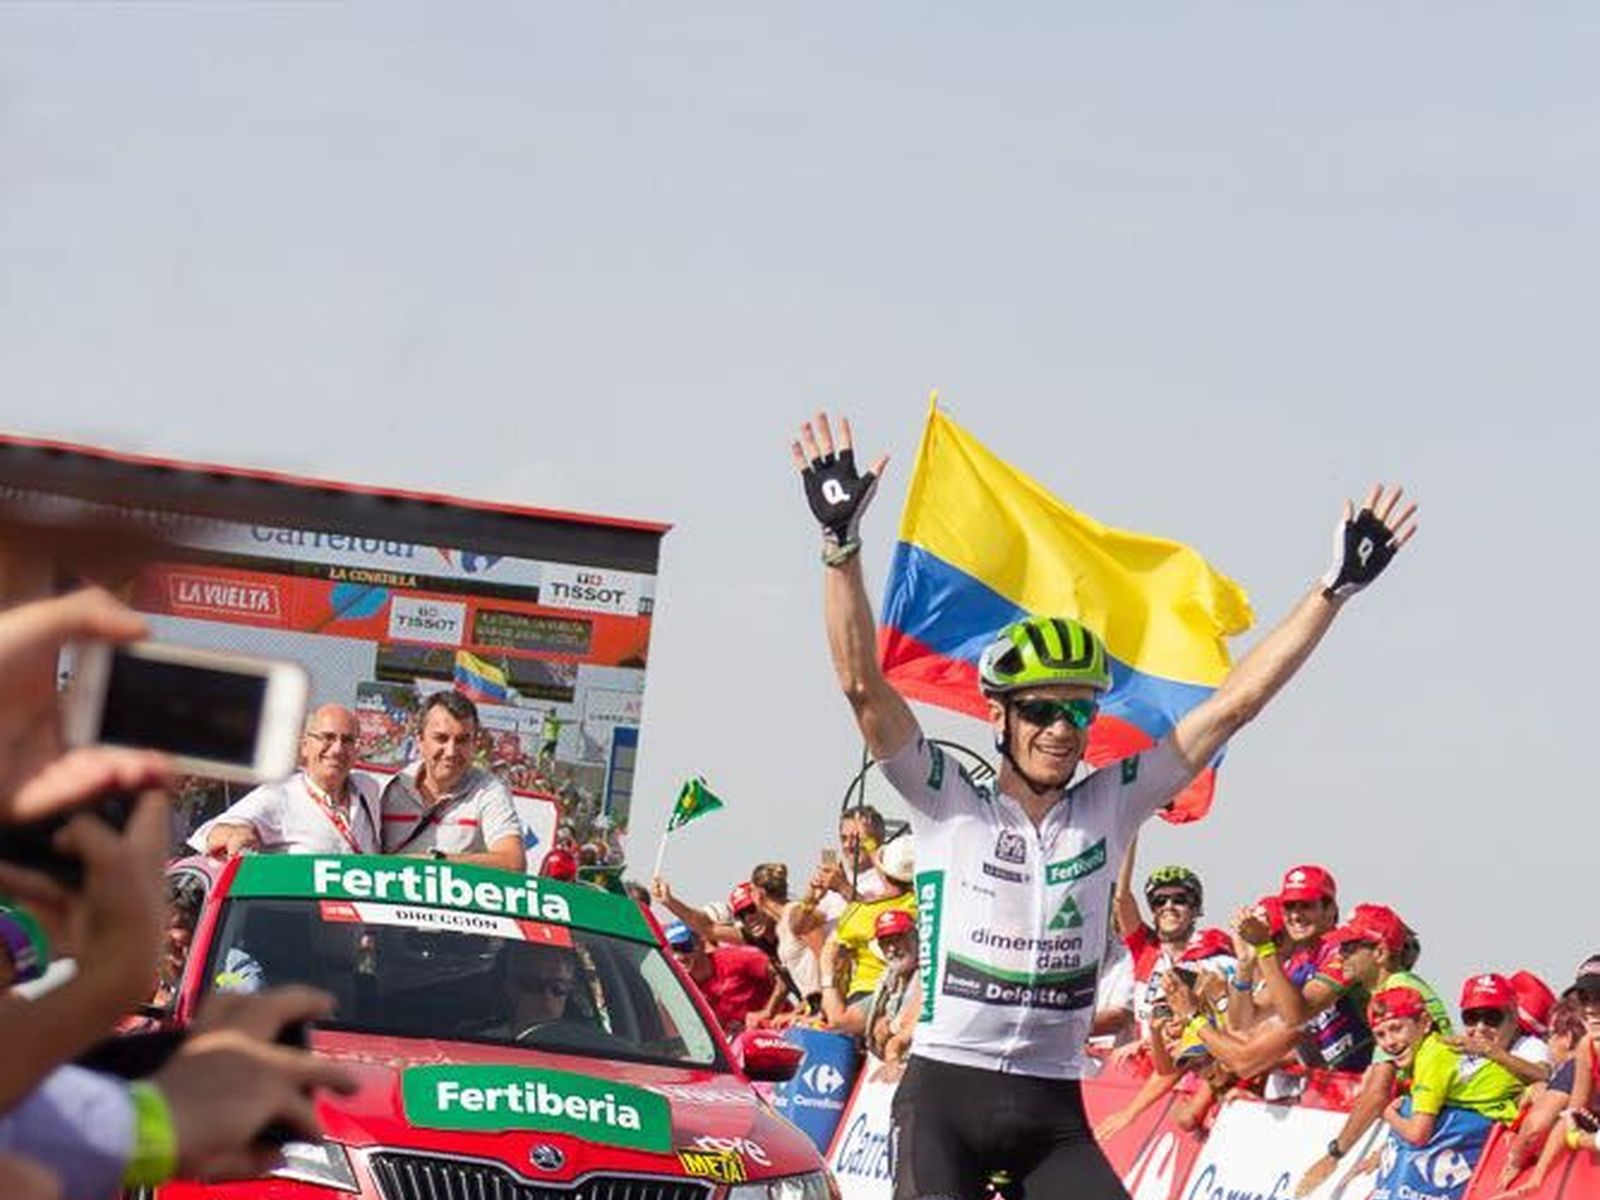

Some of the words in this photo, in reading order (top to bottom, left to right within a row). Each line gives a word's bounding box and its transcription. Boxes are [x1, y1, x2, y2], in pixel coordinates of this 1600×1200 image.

[179, 581, 200, 602] LA
[203, 584, 270, 611] VUELTA
[551, 582, 626, 604] TISSOT
[400, 616, 455, 631] TISSOT
[313, 859, 572, 922] Fertiberia
[970, 927, 1083, 952] dimension
[1036, 953, 1081, 970] data
[985, 982, 1068, 1004] Deloitte
[436, 1080, 641, 1131] Fertiberia
